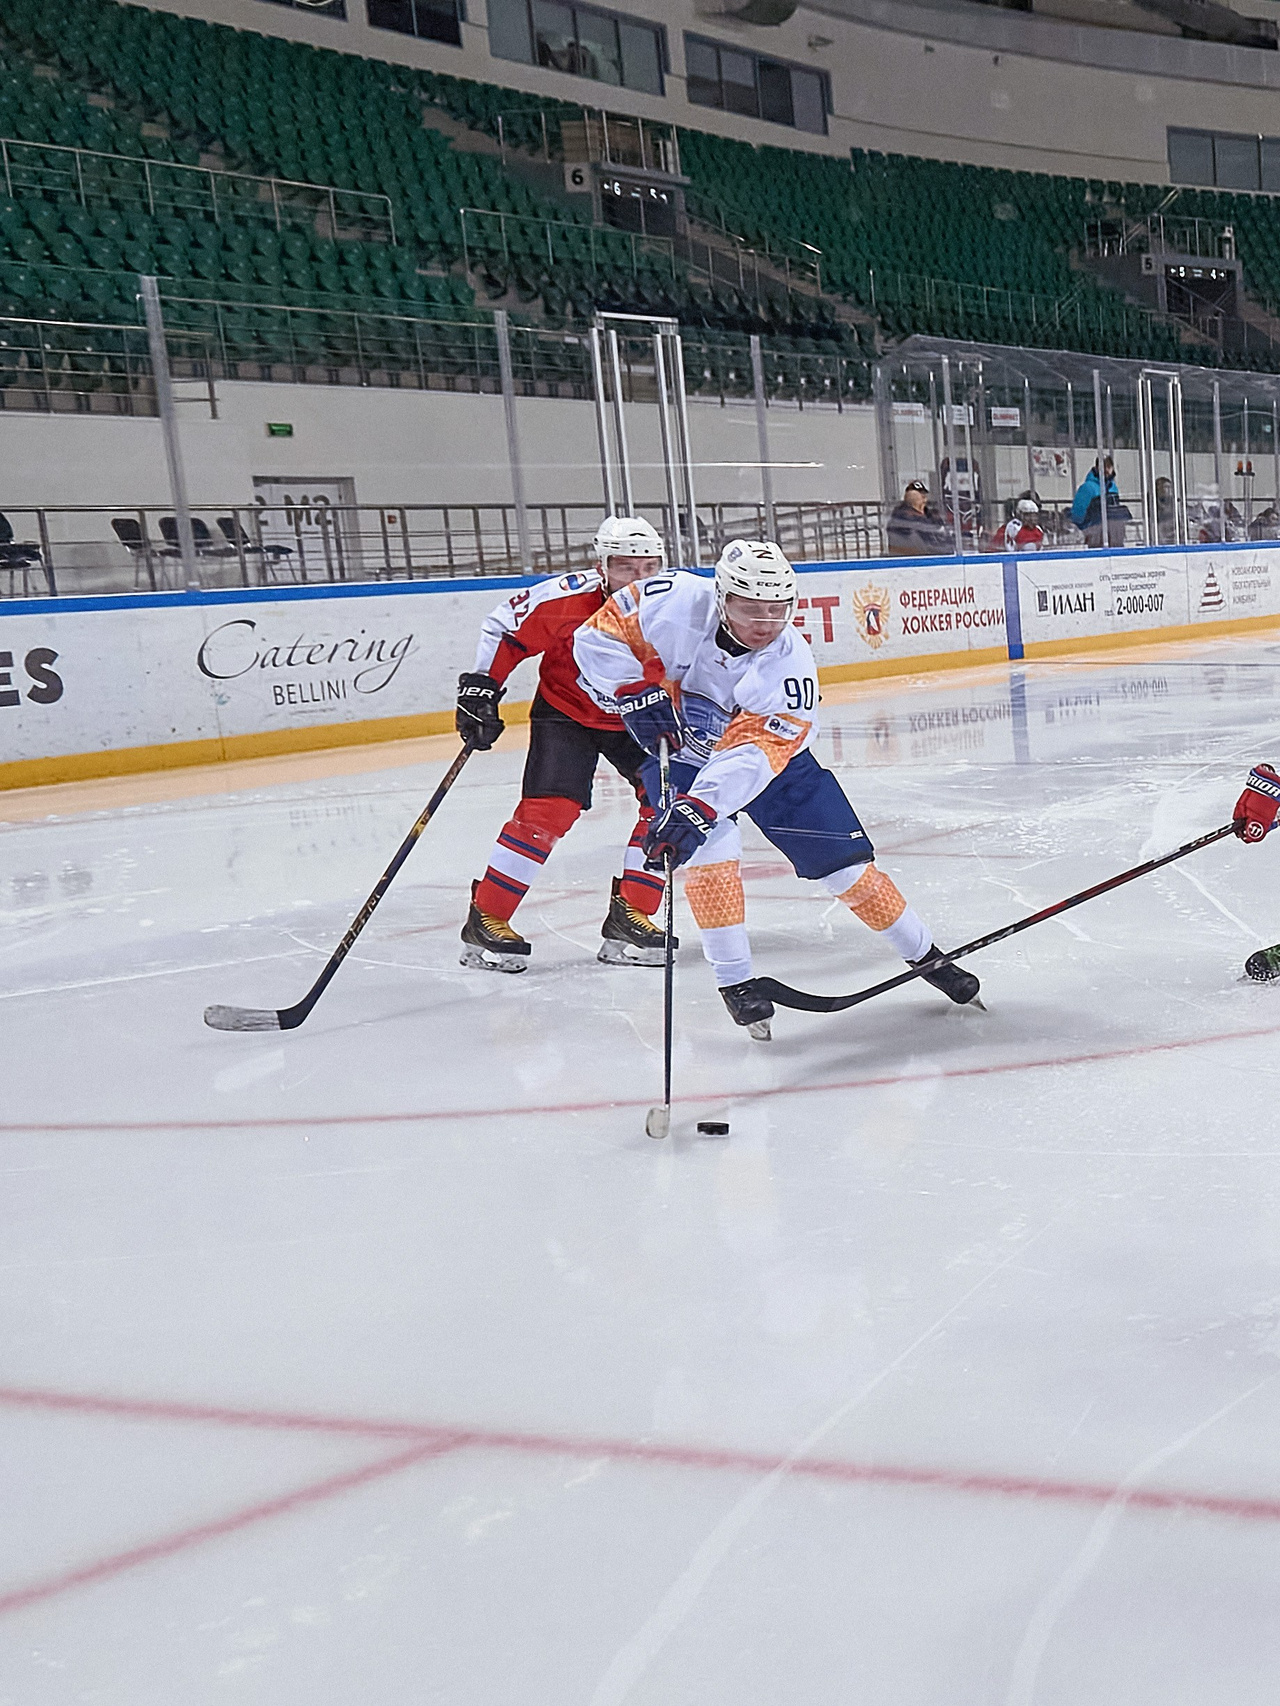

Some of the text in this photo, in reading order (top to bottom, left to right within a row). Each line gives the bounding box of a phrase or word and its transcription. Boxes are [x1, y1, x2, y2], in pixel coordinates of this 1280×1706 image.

[571, 168, 584, 185] 6
[899, 586, 976, 611] ФЕДЕРАЦИЯ
[1052, 591, 1095, 616] ИЛАН
[1116, 593, 1164, 616] 2-000-007
[901, 608, 1005, 635] ХОККЕЯ РОССИИ
[197, 619, 415, 695] Catering
[272, 679, 348, 706] BELLINI
[783, 677, 815, 710] 90
